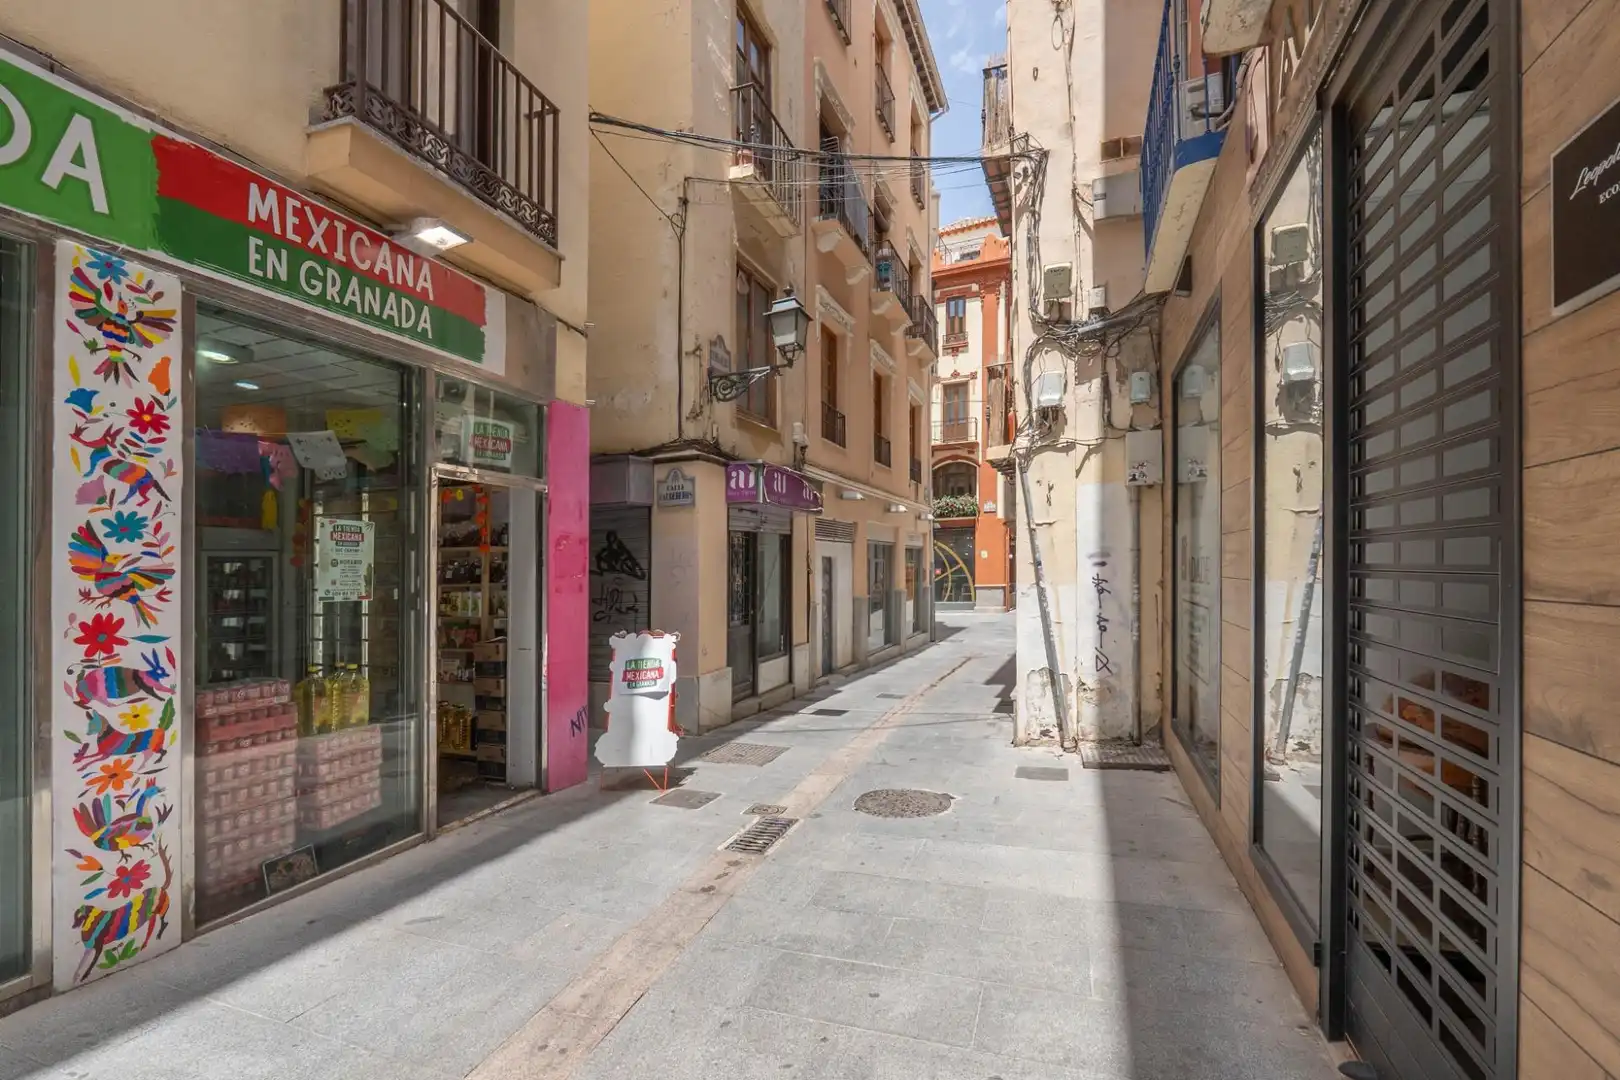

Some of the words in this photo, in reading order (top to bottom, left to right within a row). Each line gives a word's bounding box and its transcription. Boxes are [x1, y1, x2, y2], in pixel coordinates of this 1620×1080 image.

[1599, 181, 1620, 204] ECO
[248, 182, 434, 301] MEXICANA
[249, 236, 288, 282] EN
[300, 260, 433, 338] GRANADA
[474, 435, 508, 452] MEXICANA
[332, 532, 362, 541] MEXICANA
[626, 660, 636, 669] LA
[637, 658, 661, 669] TIENDA
[626, 669, 660, 681] MEXICANA
